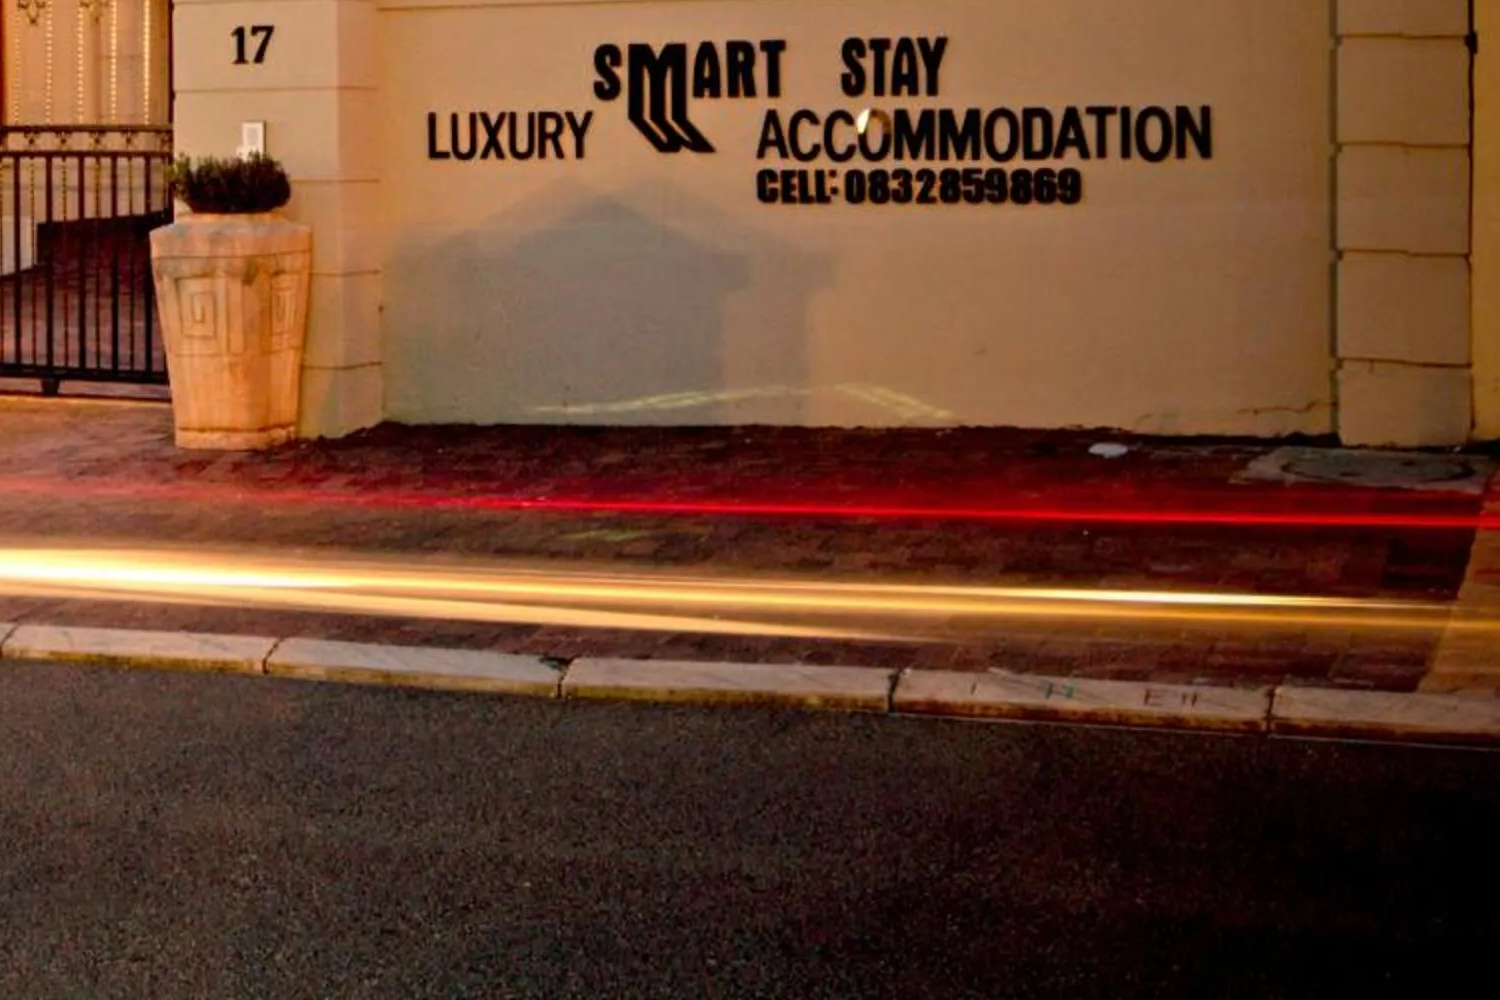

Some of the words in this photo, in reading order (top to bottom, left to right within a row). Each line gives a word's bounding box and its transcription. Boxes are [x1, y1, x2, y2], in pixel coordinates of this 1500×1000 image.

[230, 25, 274, 64] 17
[594, 40, 786, 153] SMART
[841, 37, 948, 97] STAY
[427, 111, 594, 160] LUXURY
[756, 105, 1212, 163] ACCOMMODATION
